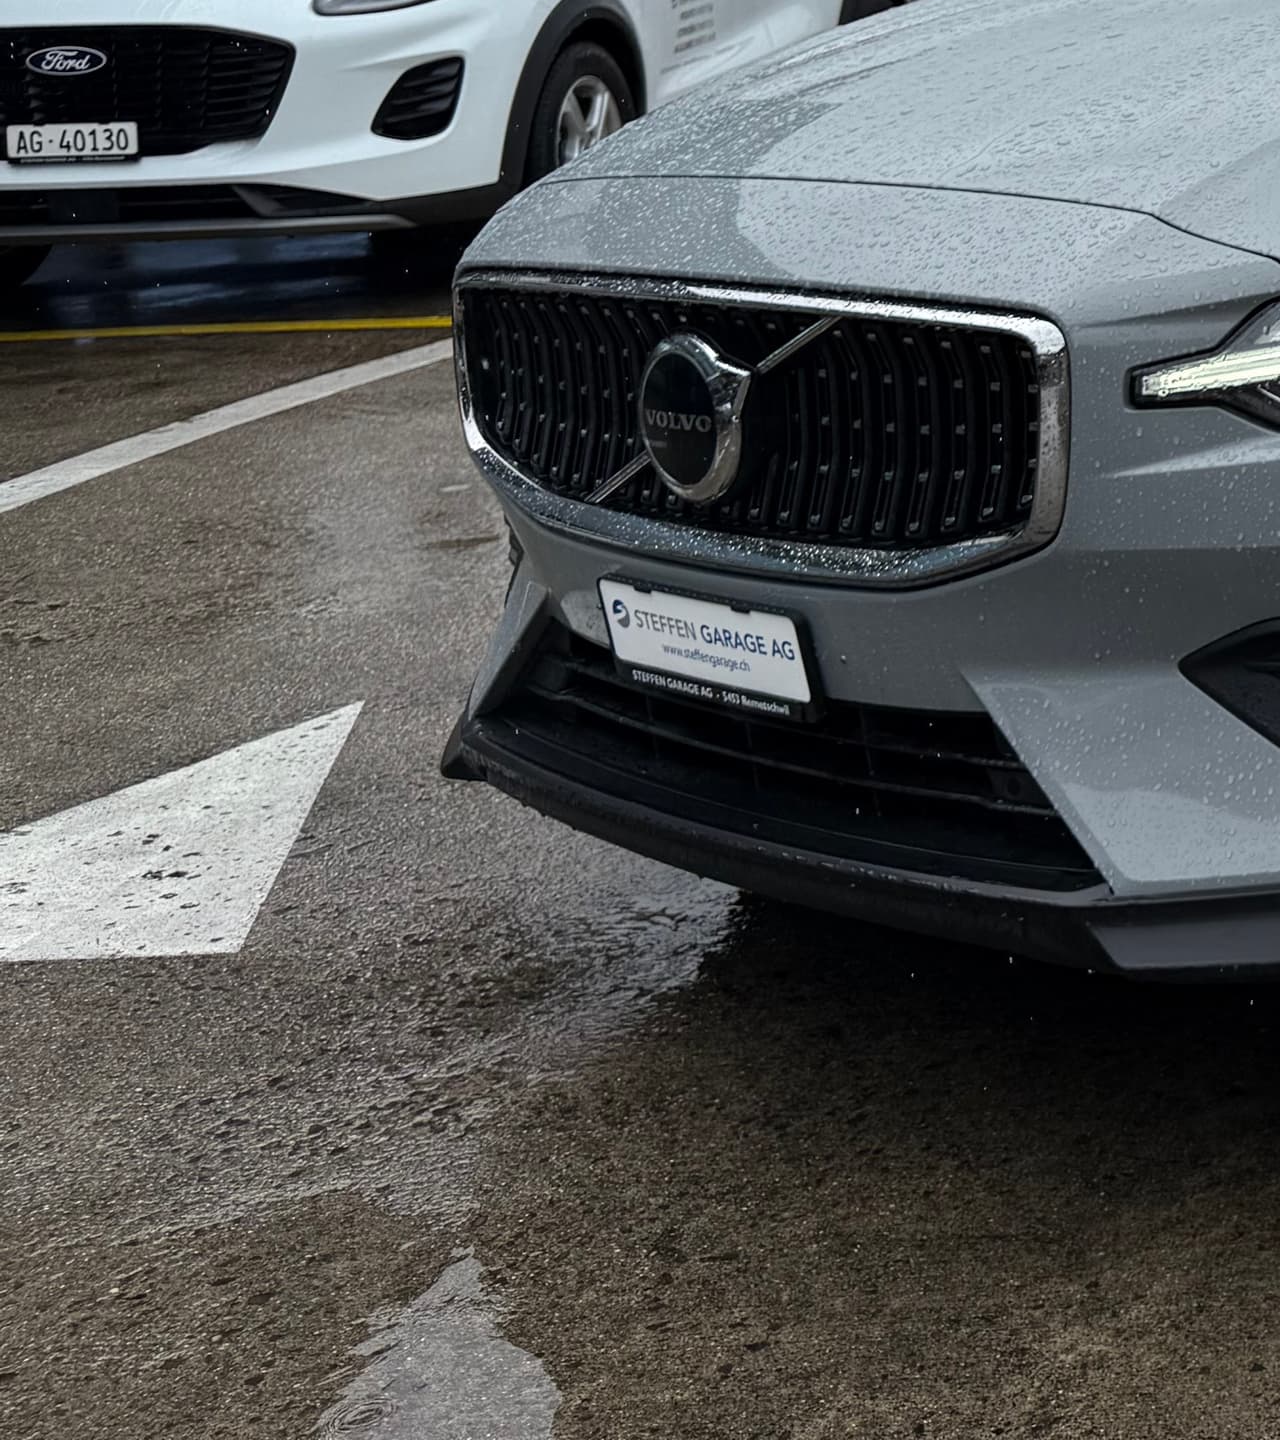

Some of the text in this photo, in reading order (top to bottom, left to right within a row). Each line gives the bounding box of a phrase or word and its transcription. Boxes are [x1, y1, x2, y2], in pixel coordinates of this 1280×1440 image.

[41, 50, 92, 71] Ford
[16, 128, 129, 154] AG 40130
[646, 410, 712, 433] VOLVO
[633, 609, 796, 660] STEFFEN GARAGE AG
[632, 669, 666, 687] STEFFEN
[667, 677, 700, 696] GARAGE
[701, 686, 713, 699] AG
